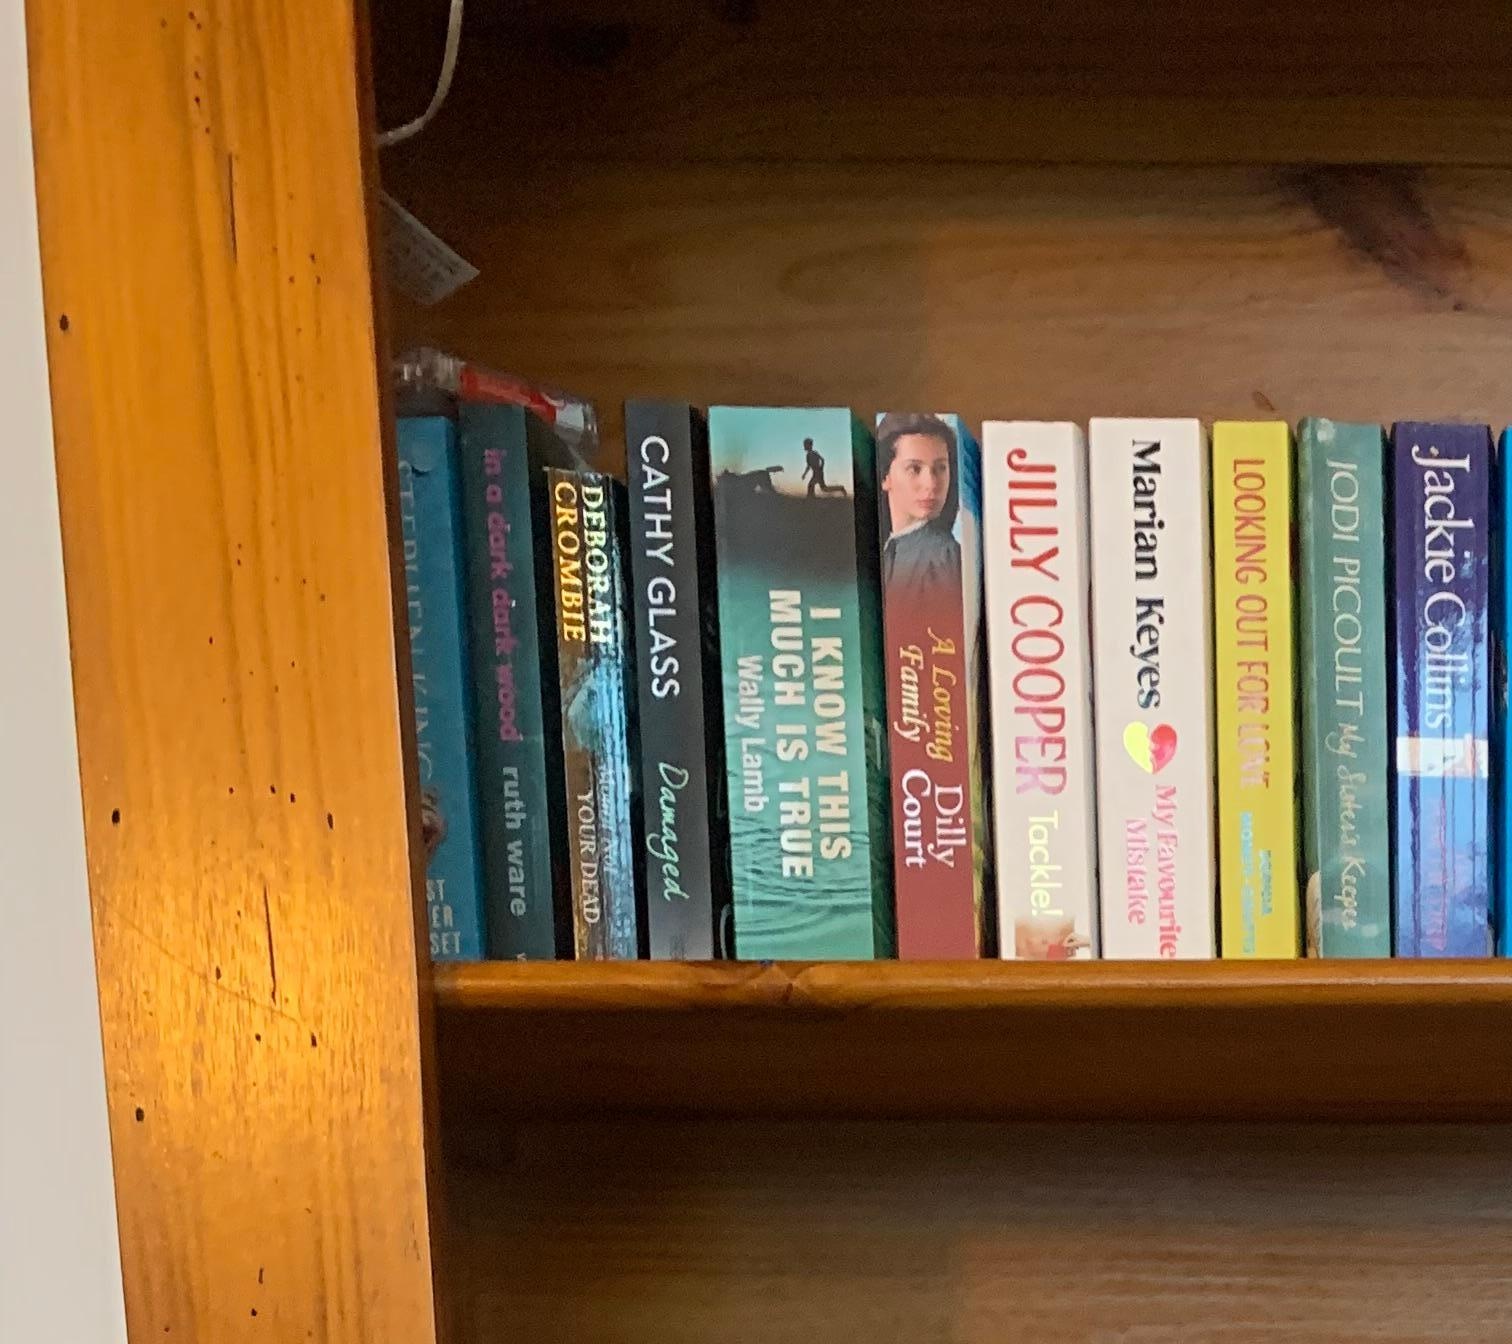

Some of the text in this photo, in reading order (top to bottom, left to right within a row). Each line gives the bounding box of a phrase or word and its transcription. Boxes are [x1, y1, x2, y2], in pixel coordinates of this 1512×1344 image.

[554, 481, 585, 641] CROMBIE
[580, 484, 614, 643] DEBORAH
[640, 436, 679, 698] CATHY GLASS
[1007, 449, 1066, 796] JILLY COOPER
[1130, 439, 1165, 709] Marian Keyes
[736, 655, 769, 812] Wally Lamb
[770, 589, 814, 879] MUCH IS TRUE
[810, 607, 851, 859] I KNOW THIS
[895, 645, 925, 742] Family
[926, 628, 958, 763] A Loving
[648, 763, 690, 900] Damaged
[901, 769, 930, 867] Court
[932, 784, 965, 867] Dilly
